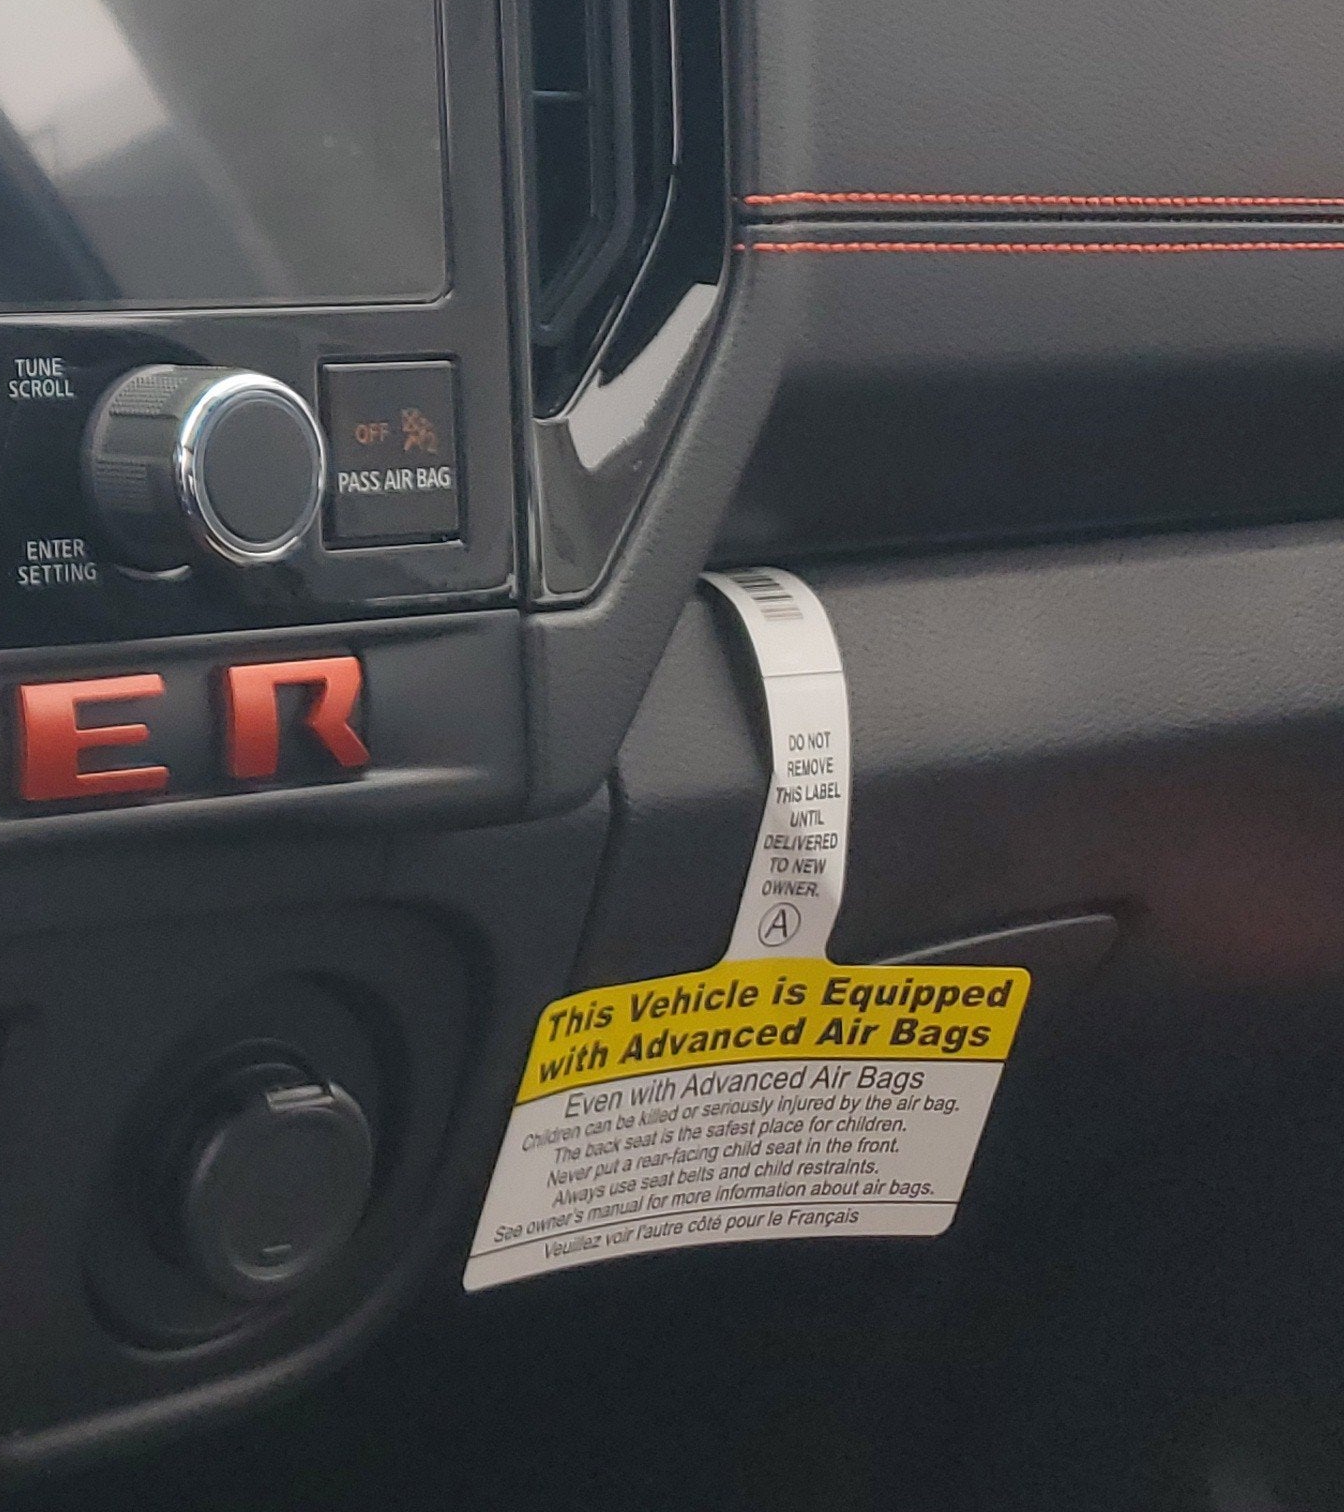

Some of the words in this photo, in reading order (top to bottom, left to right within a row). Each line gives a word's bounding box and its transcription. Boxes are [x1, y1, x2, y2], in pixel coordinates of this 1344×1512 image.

[14, 357, 65, 377] TUNE
[9, 379, 74, 398] SCROLL
[355, 422, 389, 445] OFF
[338, 471, 381, 493] PASS
[384, 468, 413, 490] AIR
[416, 466, 452, 488] BAG
[26, 539, 85, 561] ENTER
[18, 562, 96, 585] SETTING
[789, 734, 805, 751] DO
[808, 731, 830, 749] NOT
[787, 757, 833, 778] REMOVE
[776, 786, 802, 804] THIS
[805, 781, 841, 801] LABEL
[789, 809, 824, 828] UNTIL
[763, 832, 838, 851] DELIVERED
[769, 857, 789, 873] TO
[792, 858, 826, 875] NEW
[761, 879, 819, 897] OWNER.
[549, 1000, 614, 1042] This
[630, 979, 759, 1022] Vehicle
[772, 976, 807, 1005] is
[821, 976, 1014, 1013] Equipped
[539, 1040, 609, 1083] with
[618, 1016, 806, 1064] Advanced
[815, 1017, 880, 1045] Air
[889, 1017, 992, 1054] Bags
[564, 1088, 623, 1118] Even
[631, 1076, 676, 1106] with
[680, 1066, 807, 1103] Advanced
[810, 1065, 851, 1088] Air
[857, 1065, 925, 1094] Bags
[522, 1125, 581, 1152] Children
[584, 1121, 612, 1137] can
[616, 1114, 635, 1130] be
[638, 1104, 677, 1127] killed
[682, 1104, 698, 1119] or
[702, 1097, 773, 1118] seriously
[777, 1095, 835, 1115] injured
[839, 1094, 862, 1113] by
[865, 1095, 891, 1111] the
[896, 1095, 916, 1111] air
[923, 1096, 960, 1115] bag.
[555, 1146, 580, 1164] The
[585, 1142, 619, 1158] back
[623, 1132, 657, 1150] seat
[661, 1127, 674, 1144] is
[678, 1124, 703, 1141] the
[706, 1118, 755, 1139] safest
[758, 1118, 803, 1142] place
[809, 1116, 832, 1133] for
[836, 1116, 907, 1133] children.
[547, 1164, 592, 1188] Never
[594, 1160, 618, 1179] put
[622, 1158, 633, 1173] a
[636, 1142, 719, 1169] rear-facing
[722, 1140, 761, 1158] child
[766, 1139, 801, 1156] seat
[805, 1138, 820, 1154] in
[826, 1138, 852, 1153] the
[857, 1137, 899, 1153] front.
[552, 1183, 605, 1209] Always
[609, 1180, 636, 1196] use
[640, 1172, 673, 1189] seat
[677, 1164, 714, 1185] belts
[718, 1163, 750, 1180] and
[754, 1158, 791, 1177] child
[796, 1158, 879, 1175] restraints.
[494, 1224, 522, 1242] See
[526, 1209, 584, 1235] owner's
[587, 1196, 644, 1221] manual
[647, 1193, 668, 1210] for
[671, 1188, 711, 1207] more
[715, 1181, 806, 1202] information
[811, 1179, 859, 1196] about
[863, 1179, 886, 1195] air
[889, 1179, 934, 1198] bags.
[543, 1234, 602, 1259] Veuillez
[606, 1226, 634, 1246] voir
[687, 1215, 722, 1232] côté
[725, 1214, 766, 1233] pour
[767, 1211, 782, 1227] le
[787, 1208, 859, 1228] Français
